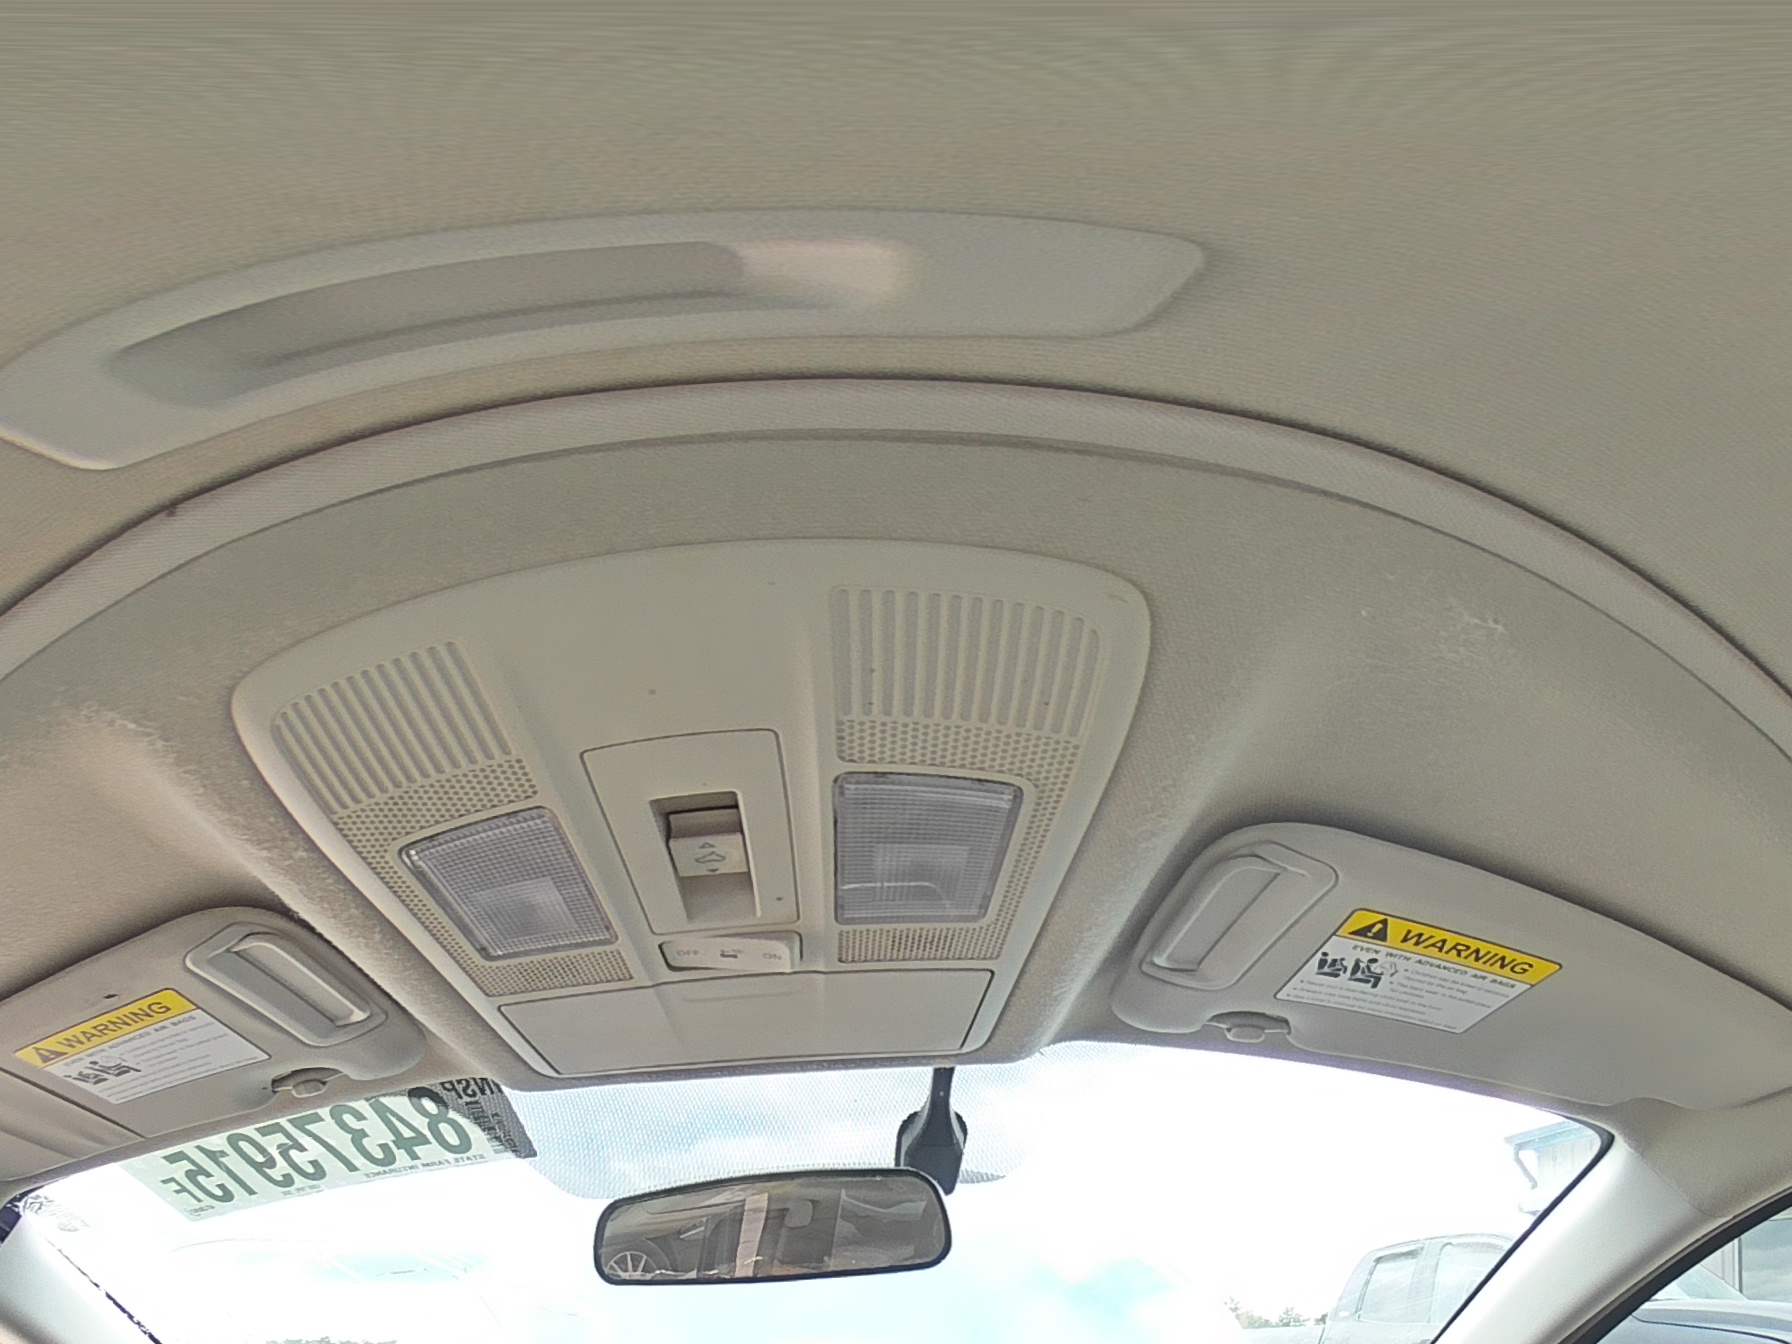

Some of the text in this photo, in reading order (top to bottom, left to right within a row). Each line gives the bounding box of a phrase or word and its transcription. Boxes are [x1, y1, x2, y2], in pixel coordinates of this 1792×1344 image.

[1351, 945, 1381, 956] EVEN
[1399, 928, 1535, 976] WARNING
[56, 1001, 172, 1050] WARNING
